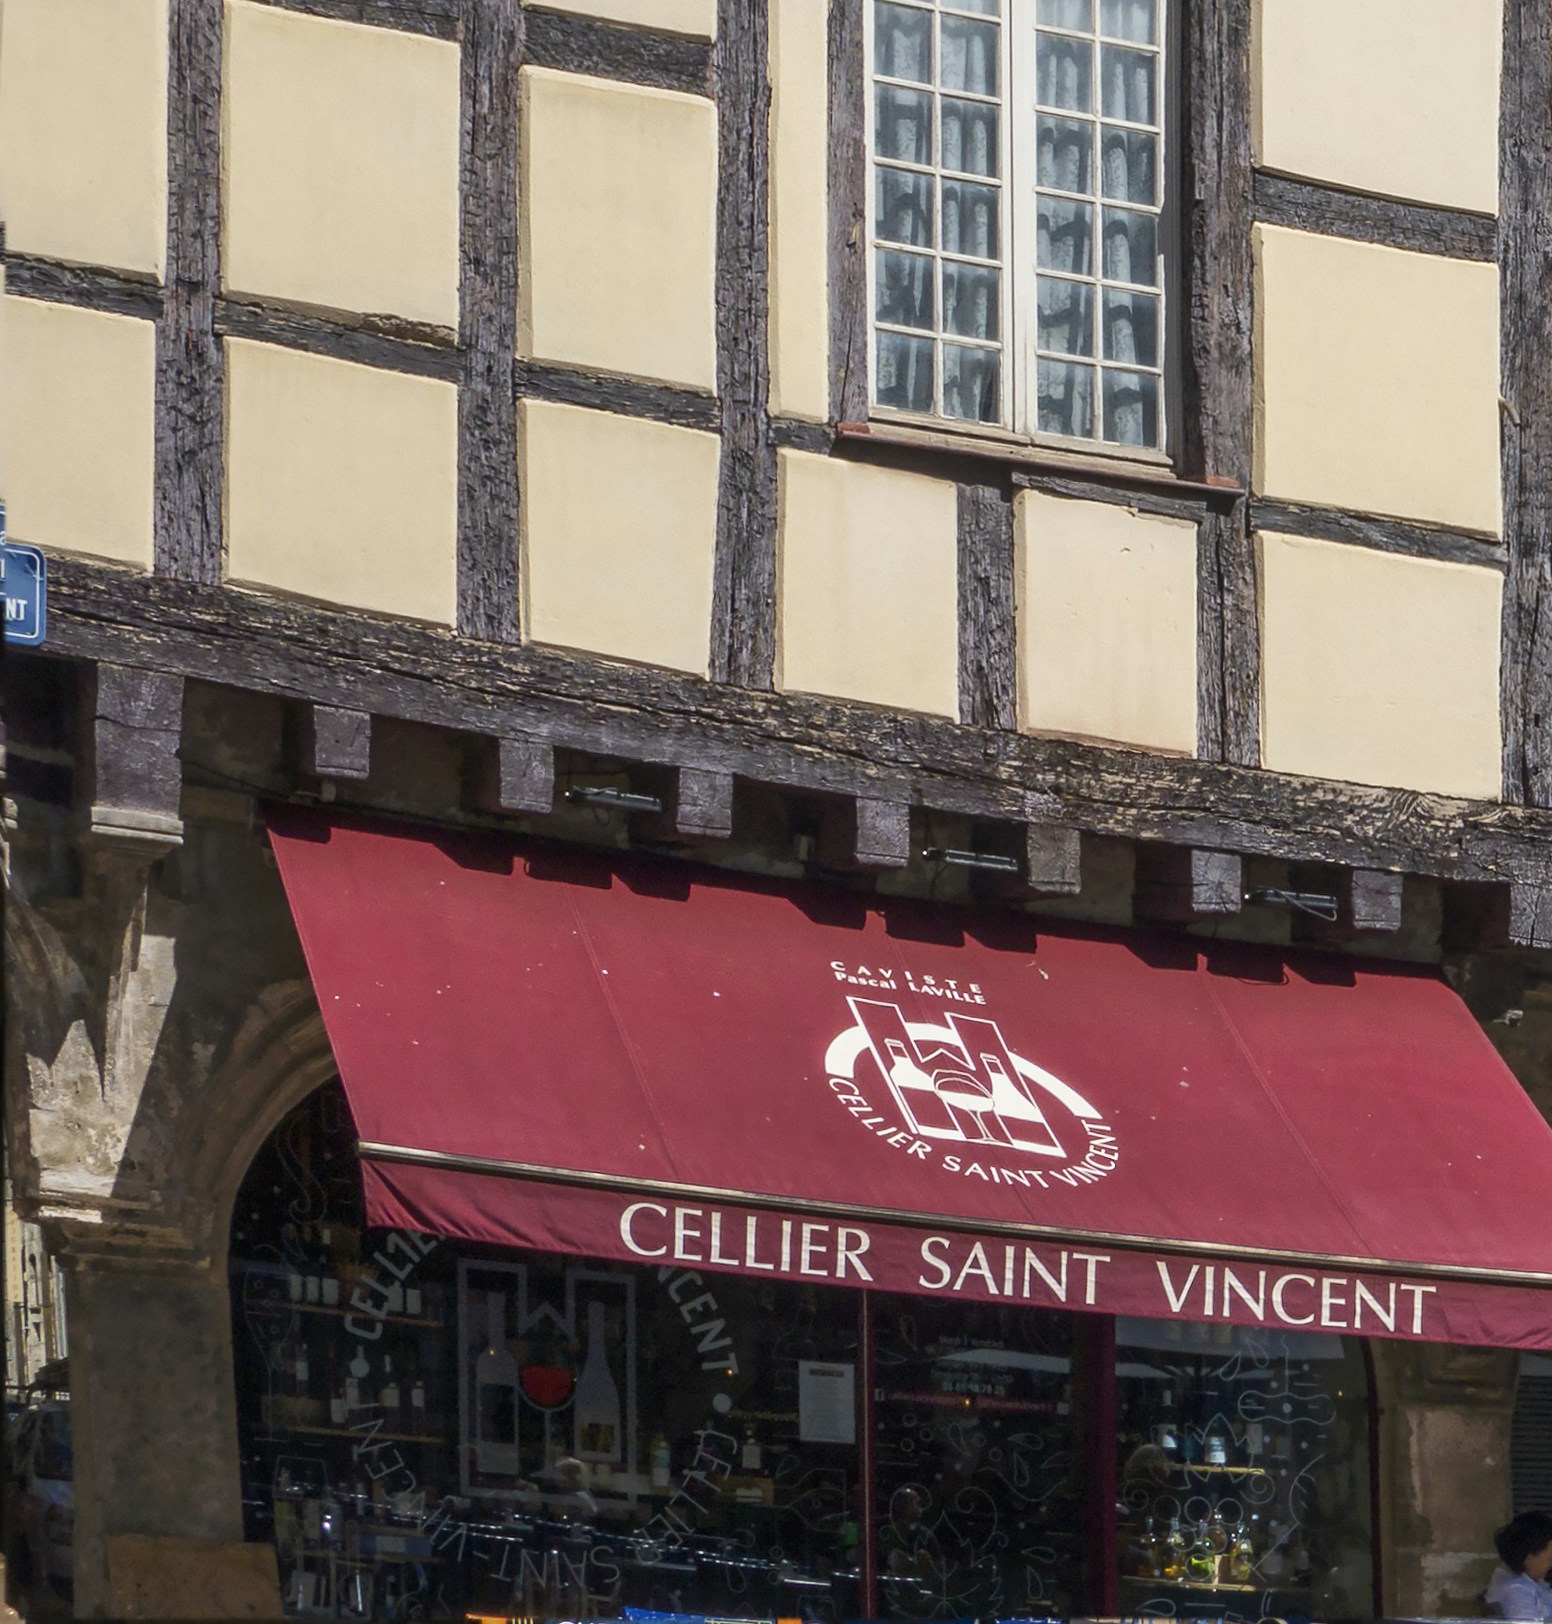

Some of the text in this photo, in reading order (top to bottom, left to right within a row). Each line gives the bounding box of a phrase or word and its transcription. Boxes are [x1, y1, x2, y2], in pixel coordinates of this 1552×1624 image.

[830, 960, 983, 995] CAVISTE
[834, 971, 987, 1005] Pascal LAVILLE
[828, 1077, 1119, 1189] CELLIER SAINT VINCENT
[619, 1202, 1437, 1334] CELLIER SAINT VINCENT
